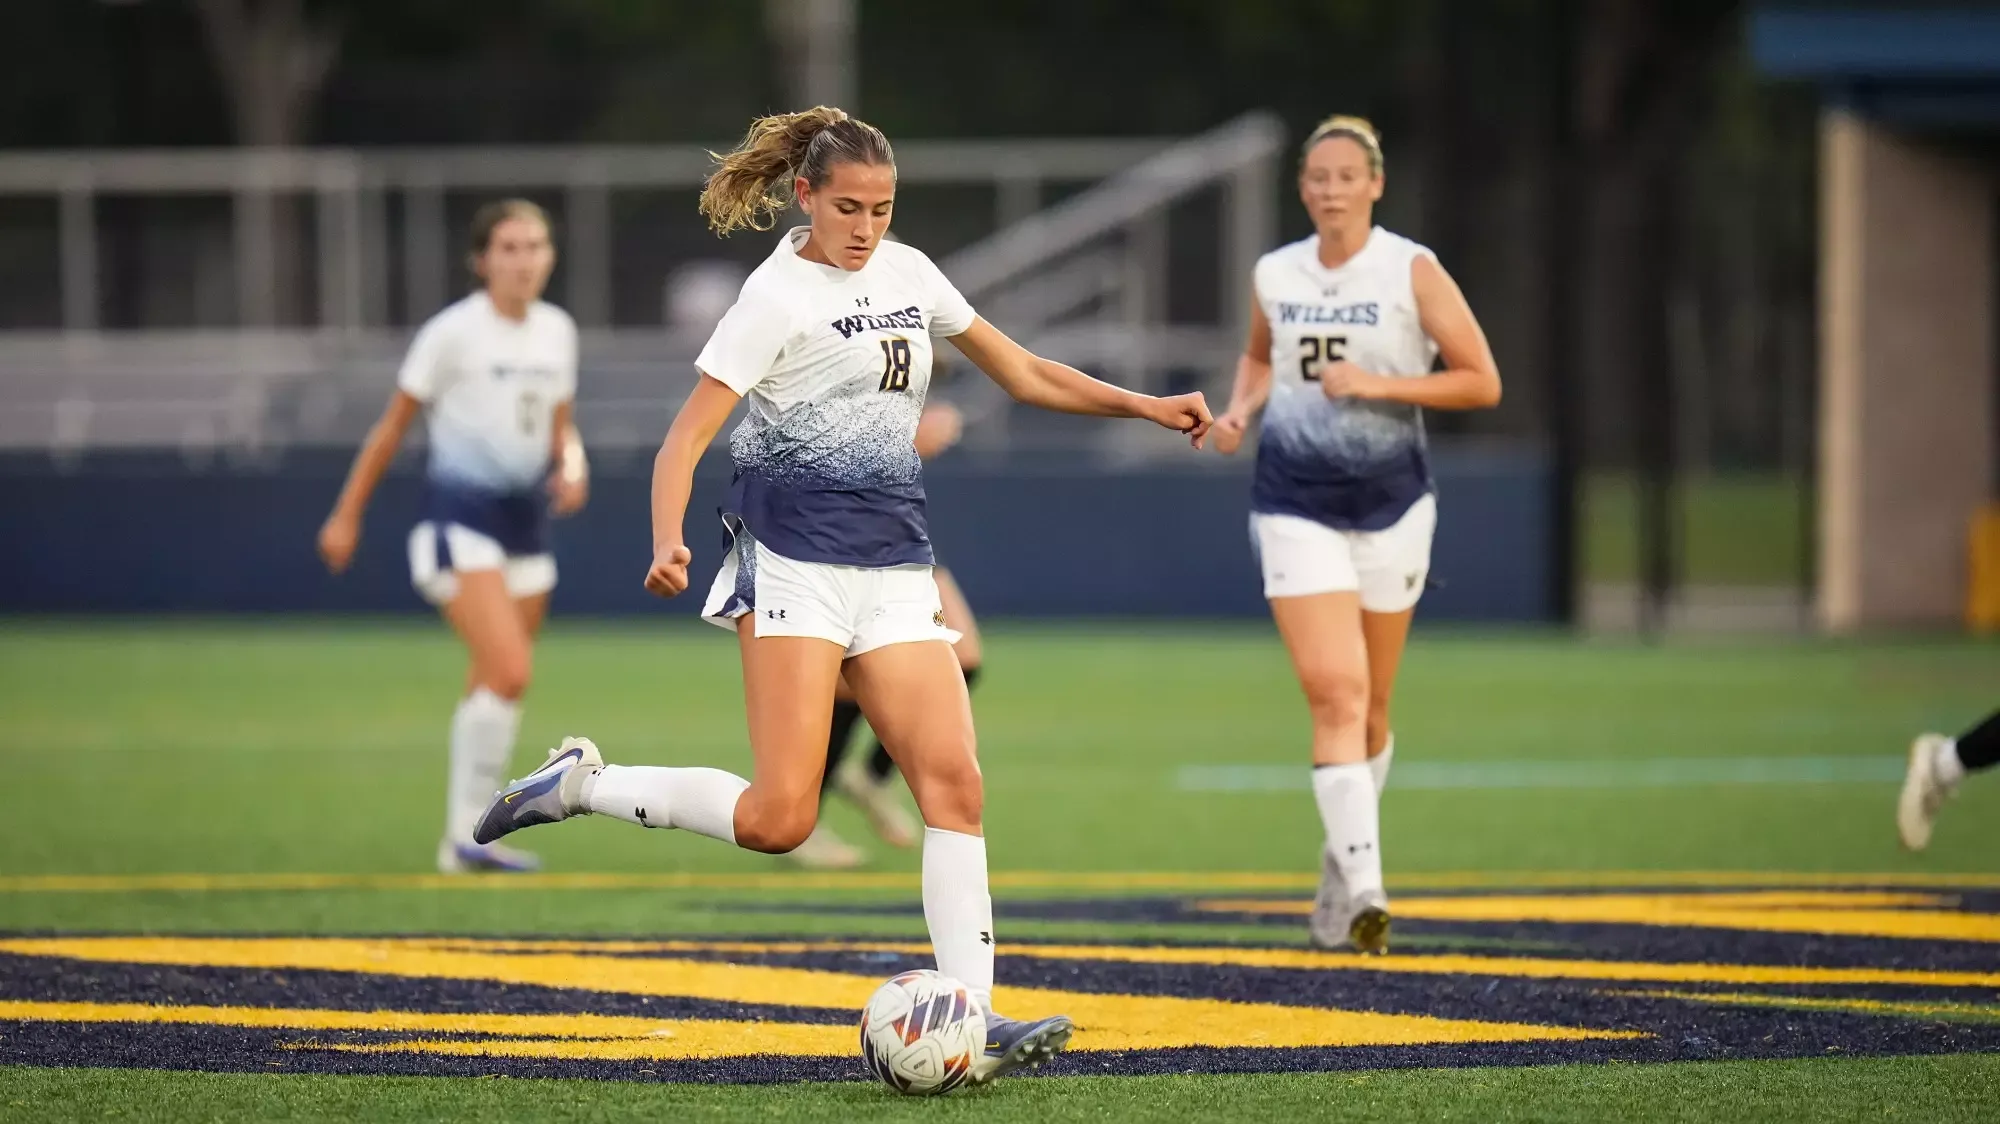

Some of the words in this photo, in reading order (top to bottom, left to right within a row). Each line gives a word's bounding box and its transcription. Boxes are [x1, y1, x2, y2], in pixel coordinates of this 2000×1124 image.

[831, 305, 925, 339] WILKES
[1278, 302, 1378, 325] WILKES
[878, 338, 912, 392] 18
